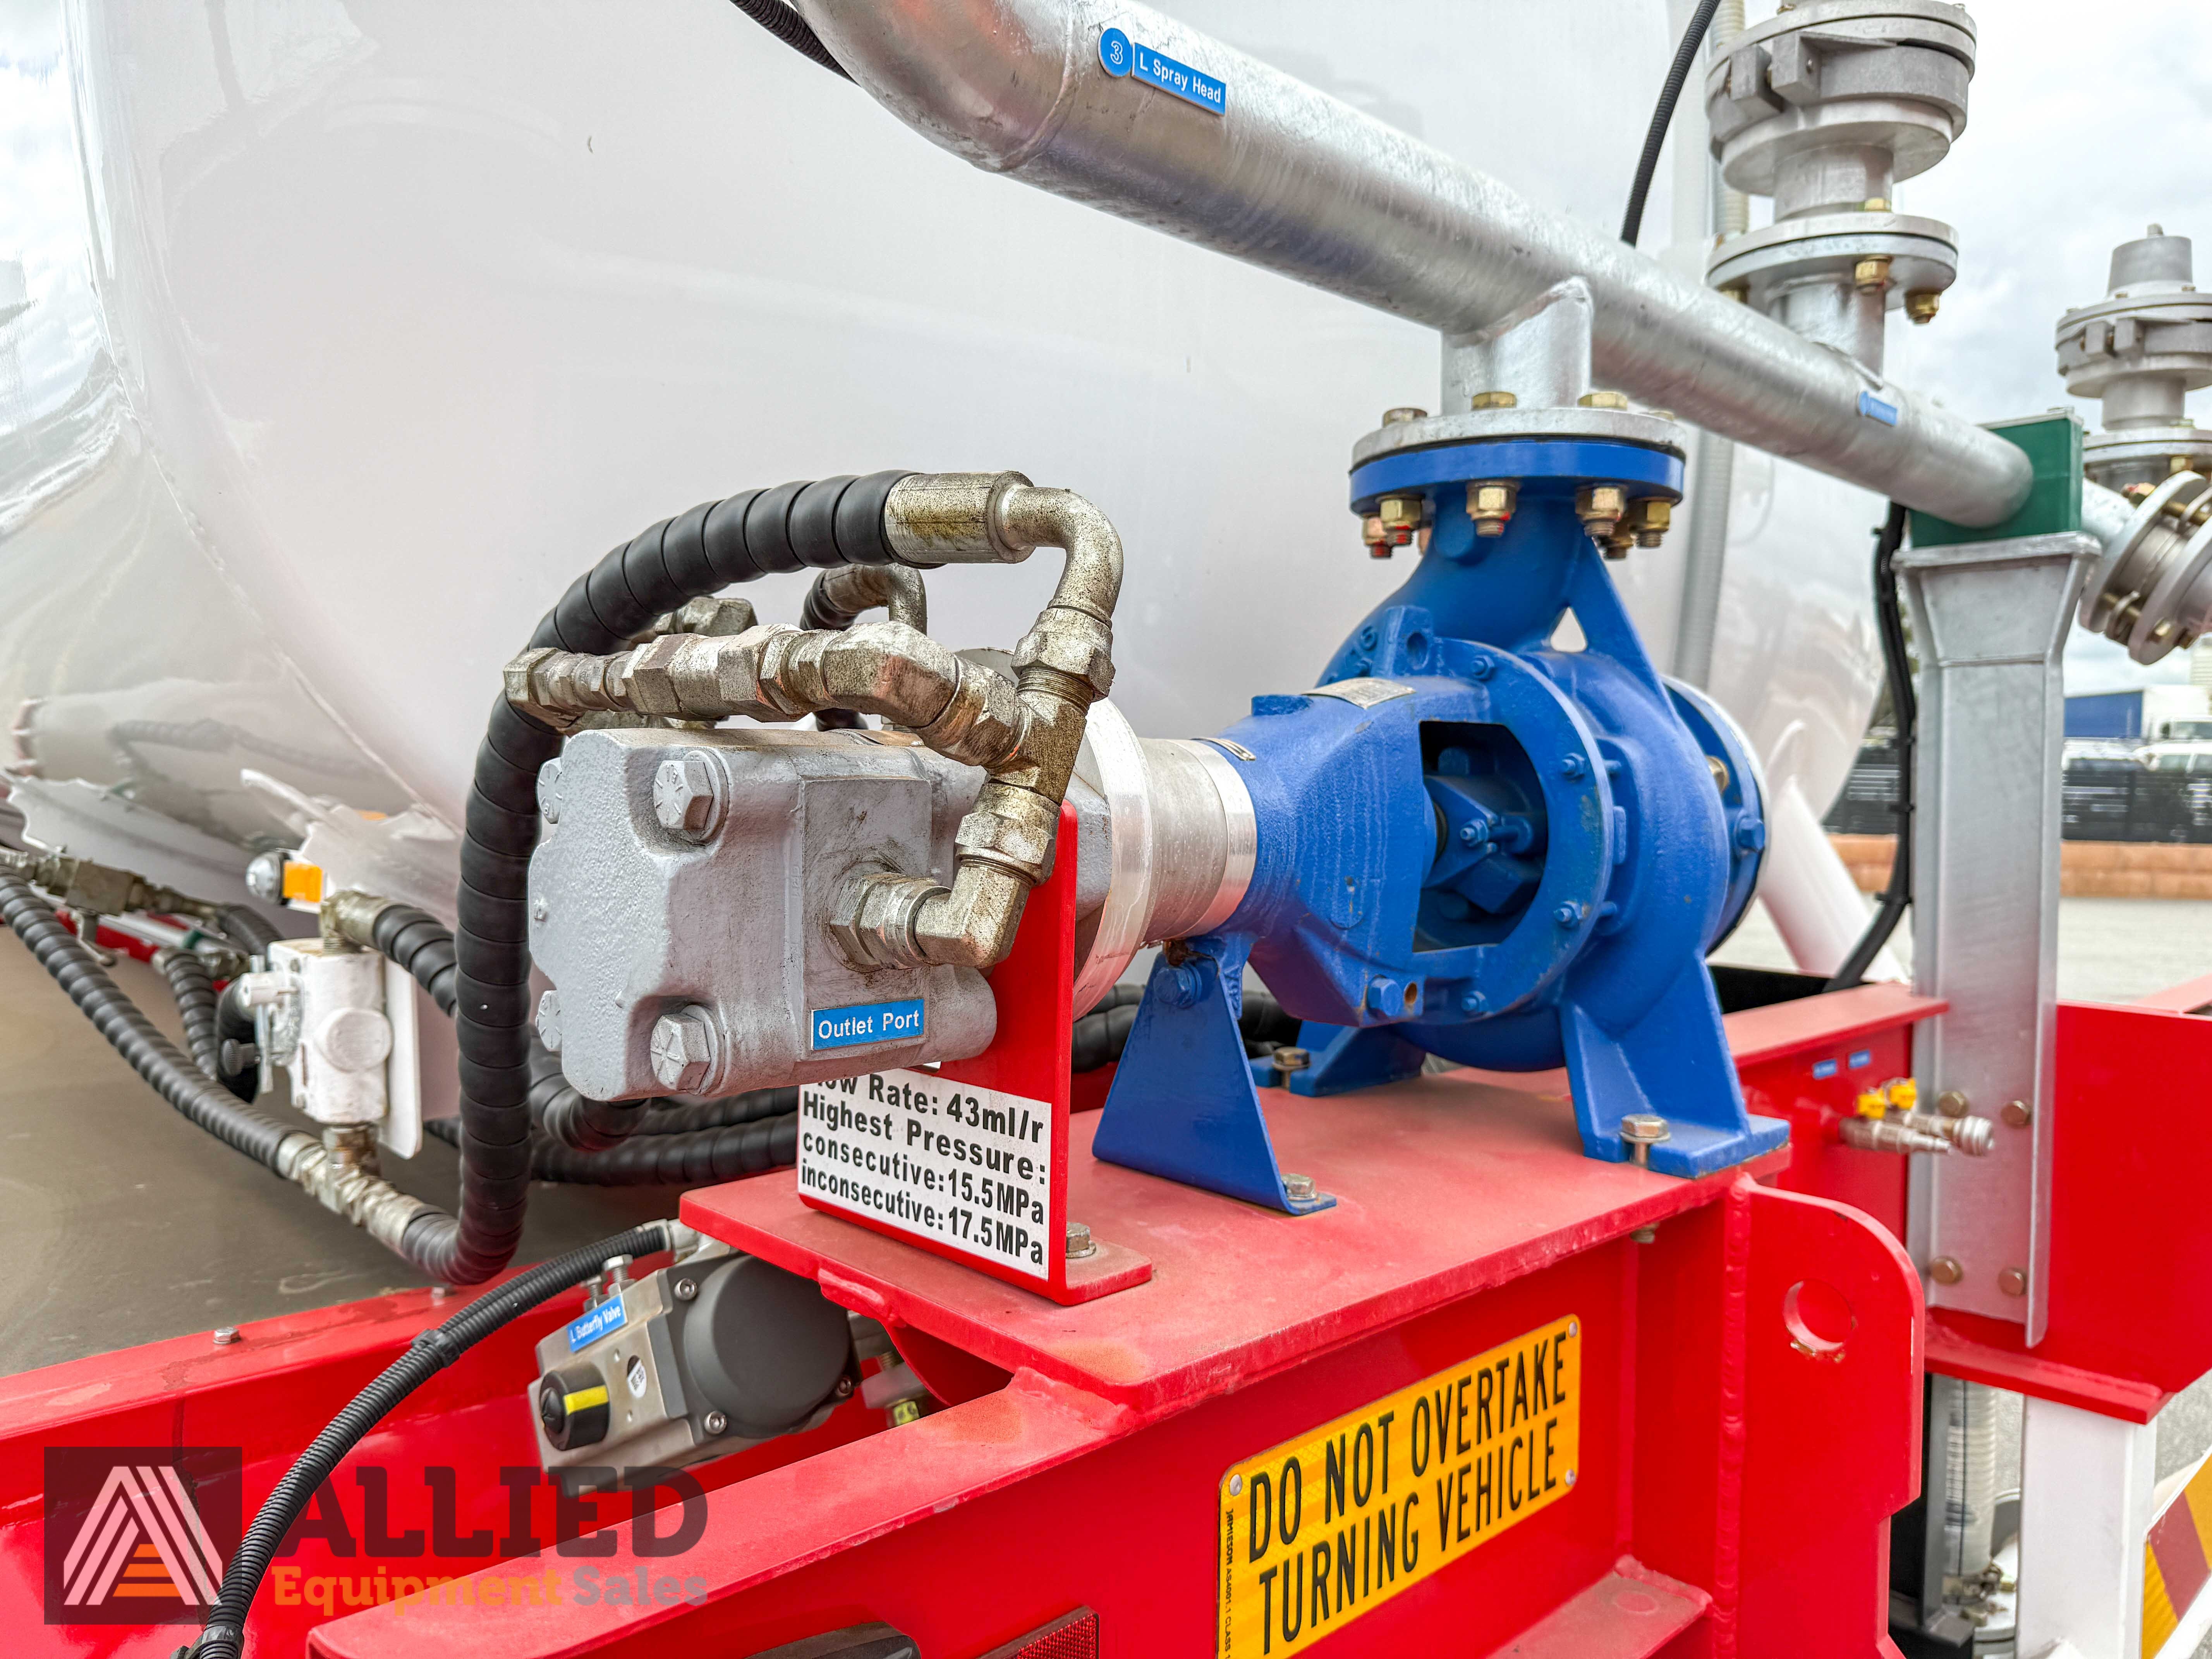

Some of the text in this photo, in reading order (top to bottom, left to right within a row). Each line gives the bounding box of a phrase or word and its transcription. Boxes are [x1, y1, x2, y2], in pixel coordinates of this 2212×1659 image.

[1110, 40, 1123, 65] 3
[1140, 52, 1221, 104] L Spray Head
[818, 1010, 919, 1039] Outlet Port
[869, 1073, 938, 1116] Rate:
[946, 1093, 1044, 1143] 43ml/r
[803, 1091, 1045, 1185] Highest Pressure:
[575, 1314, 603, 1340] Butterfly
[602, 1305, 622, 1324] Valve
[1249, 1331, 1567, 1563] DO NOT OVERTAKE
[1226, 1508, 1234, 1566] JAMIESON
[1259, 1419, 1558, 1655] TURNING VEHICLE
